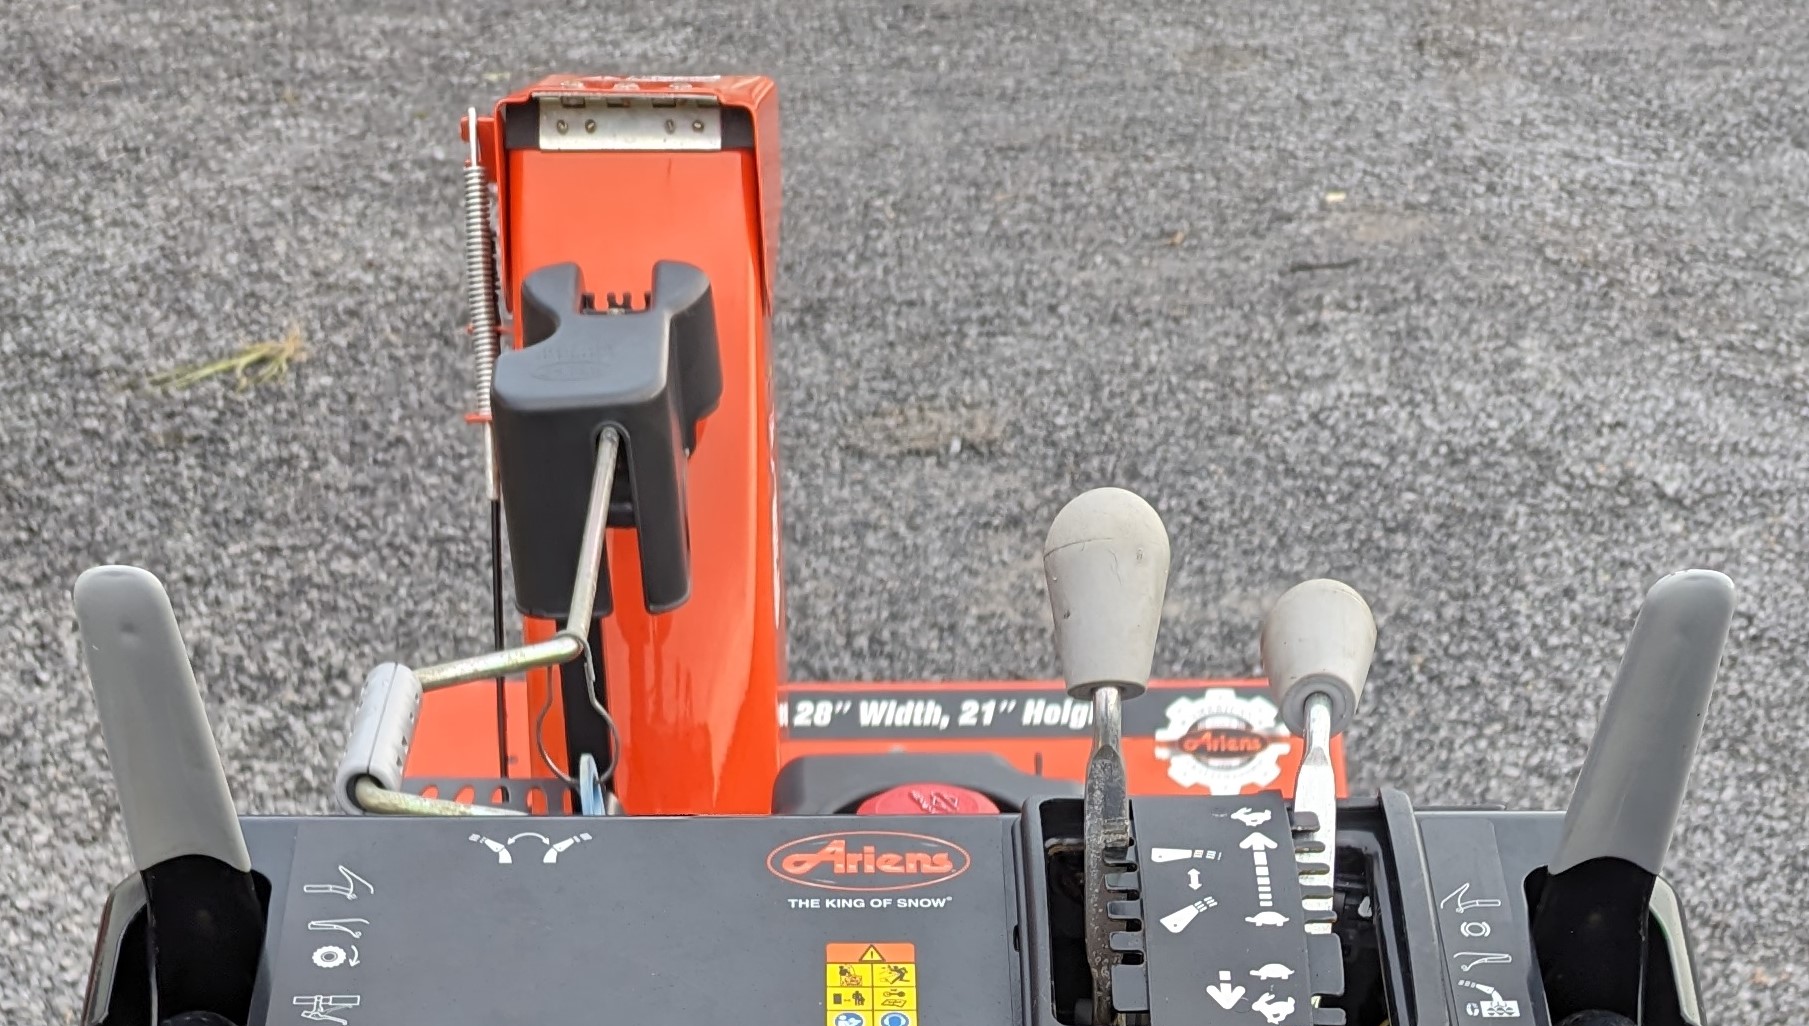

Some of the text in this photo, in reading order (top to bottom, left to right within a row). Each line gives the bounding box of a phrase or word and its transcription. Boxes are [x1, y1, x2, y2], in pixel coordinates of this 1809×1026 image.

[859, 699, 950, 731] Width,
[1022, 698, 1094, 730] Heig
[1182, 732, 1261, 752] Ariens
[782, 839, 953, 875] Ariens
[788, 898, 820, 908] THE
[825, 898, 865, 908] KING
[870, 898, 892, 908] OF
